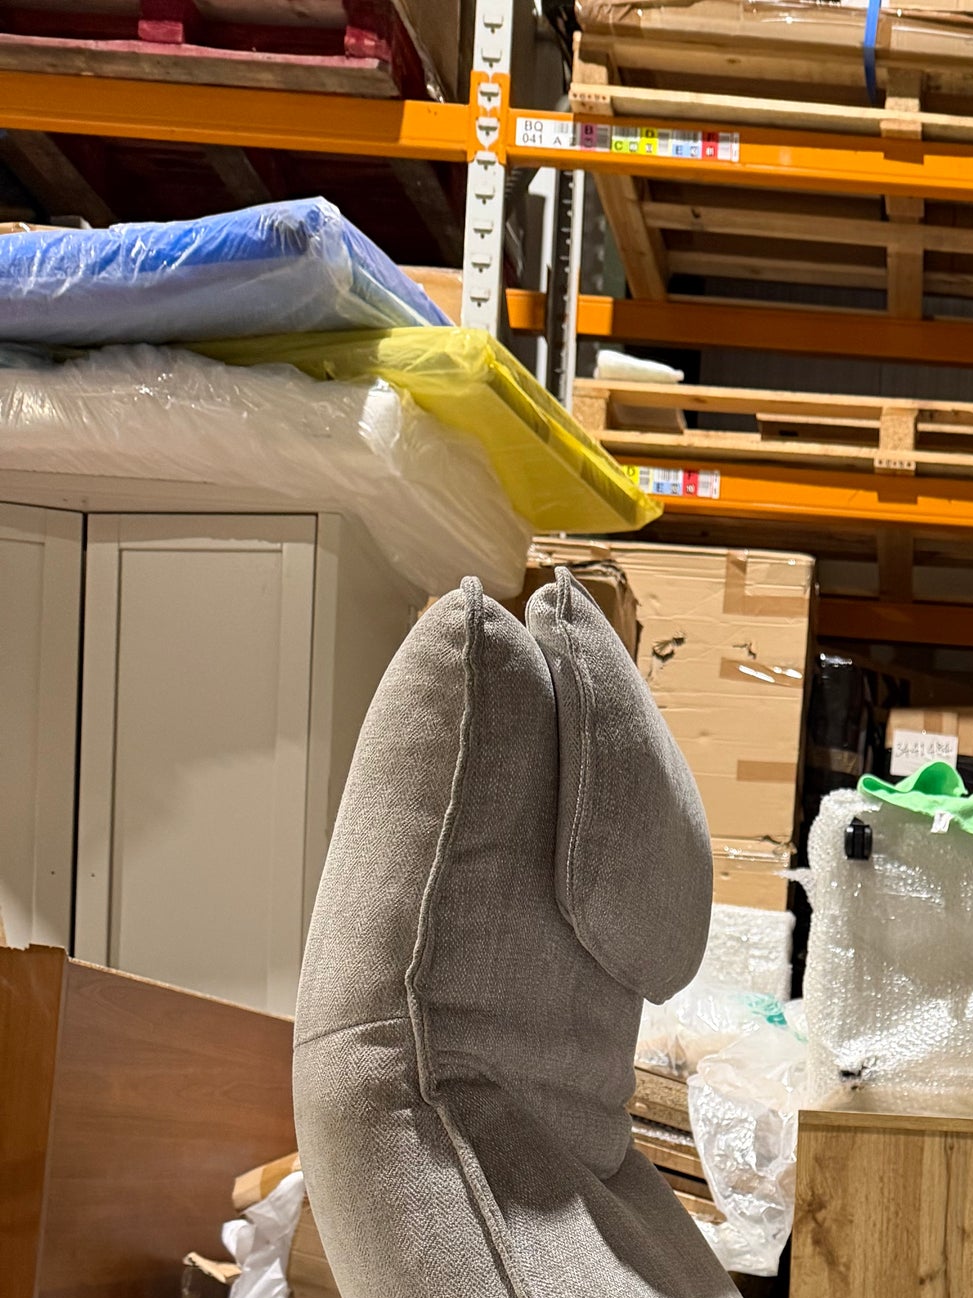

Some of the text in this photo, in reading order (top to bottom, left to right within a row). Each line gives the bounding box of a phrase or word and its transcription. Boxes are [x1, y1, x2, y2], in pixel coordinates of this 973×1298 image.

[524, 120, 544, 132] BQ
[522, 133, 543, 145] 041
[553, 136, 562, 146] A
[614, 140, 624, 151] C
[675, 145, 683, 156] E
